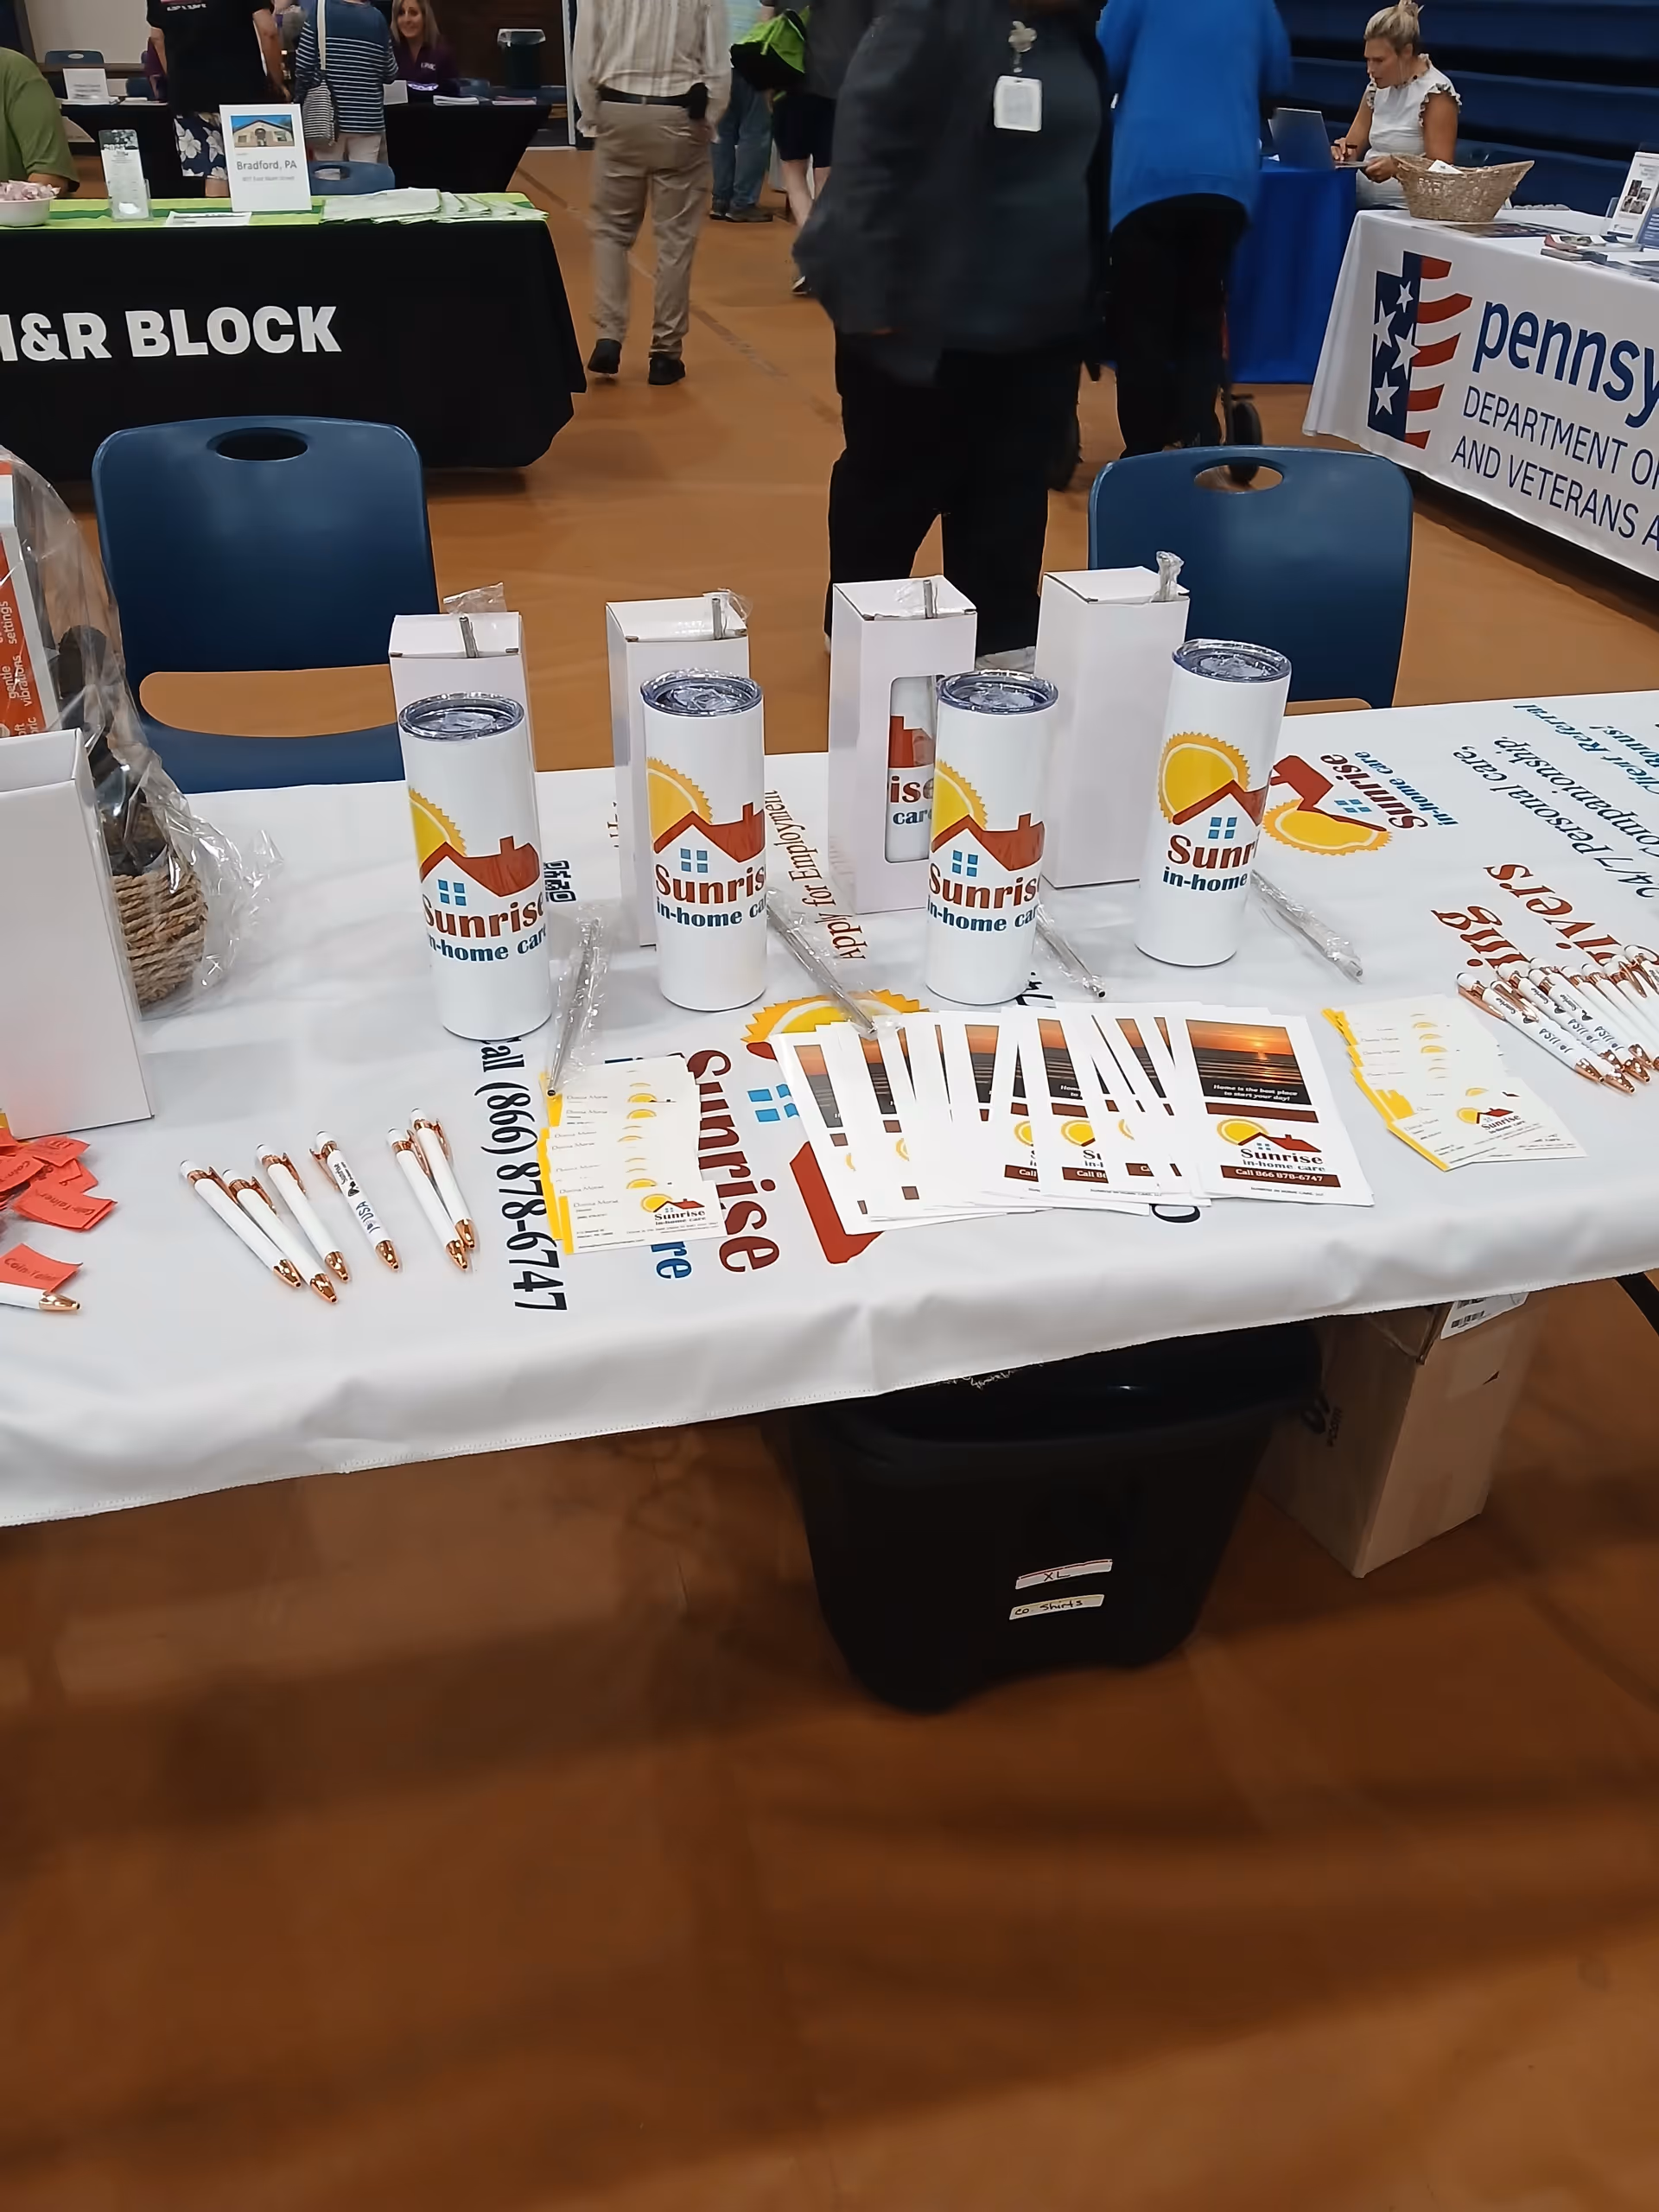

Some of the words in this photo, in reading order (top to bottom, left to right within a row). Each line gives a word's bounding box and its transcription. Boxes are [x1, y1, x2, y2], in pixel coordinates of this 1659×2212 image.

[237, 160, 283, 170] Bradford,
[284, 160, 297, 168] PA
[124, 305, 343, 358] BLOCK
[1462, 385, 1629, 474] DEPARTMENT
[1630, 448, 1659, 490] O
[1451, 435, 1502, 479] AND
[1508, 454, 1639, 538] VETERANS
[0, 601, 18, 645] settings
[2, 665, 18, 699] gentle
[1512, 704, 1611, 753] Referral
[1354, 751, 1394, 774] care
[1452, 744, 1508, 783] care,
[1319, 753, 1428, 829] Sunrise
[1389, 778, 1459, 825] in-home
[1489, 784, 1614, 855] Personal
[655, 864, 767, 904] Sunris
[801, 884, 836, 907] for
[929, 863, 1039, 910] Sunris
[1162, 866, 1248, 892] in-home
[656, 896, 742, 927] in-home
[927, 895, 1007, 931] in-home
[814, 912, 868, 959] Apply
[474, 1081, 538, 1154] (866)
[1481, 1114, 1521, 1131] Sunrise
[687, 1050, 780, 1273] Sunrise
[1076, 1169, 1096, 1179] Call
[1240, 1148, 1324, 1164] Sunrise
[1243, 1159, 1293, 1169] in-home
[1276, 1173, 1324, 1182] 878-6747
[356, 1200, 374, 1223] USA
[654, 1210, 706, 1221] Sunrise
[496, 1161, 568, 1311] 878-6747
[1043, 1571, 1071, 1582] XL
[1039, 1600, 1084, 1611] Shirts
